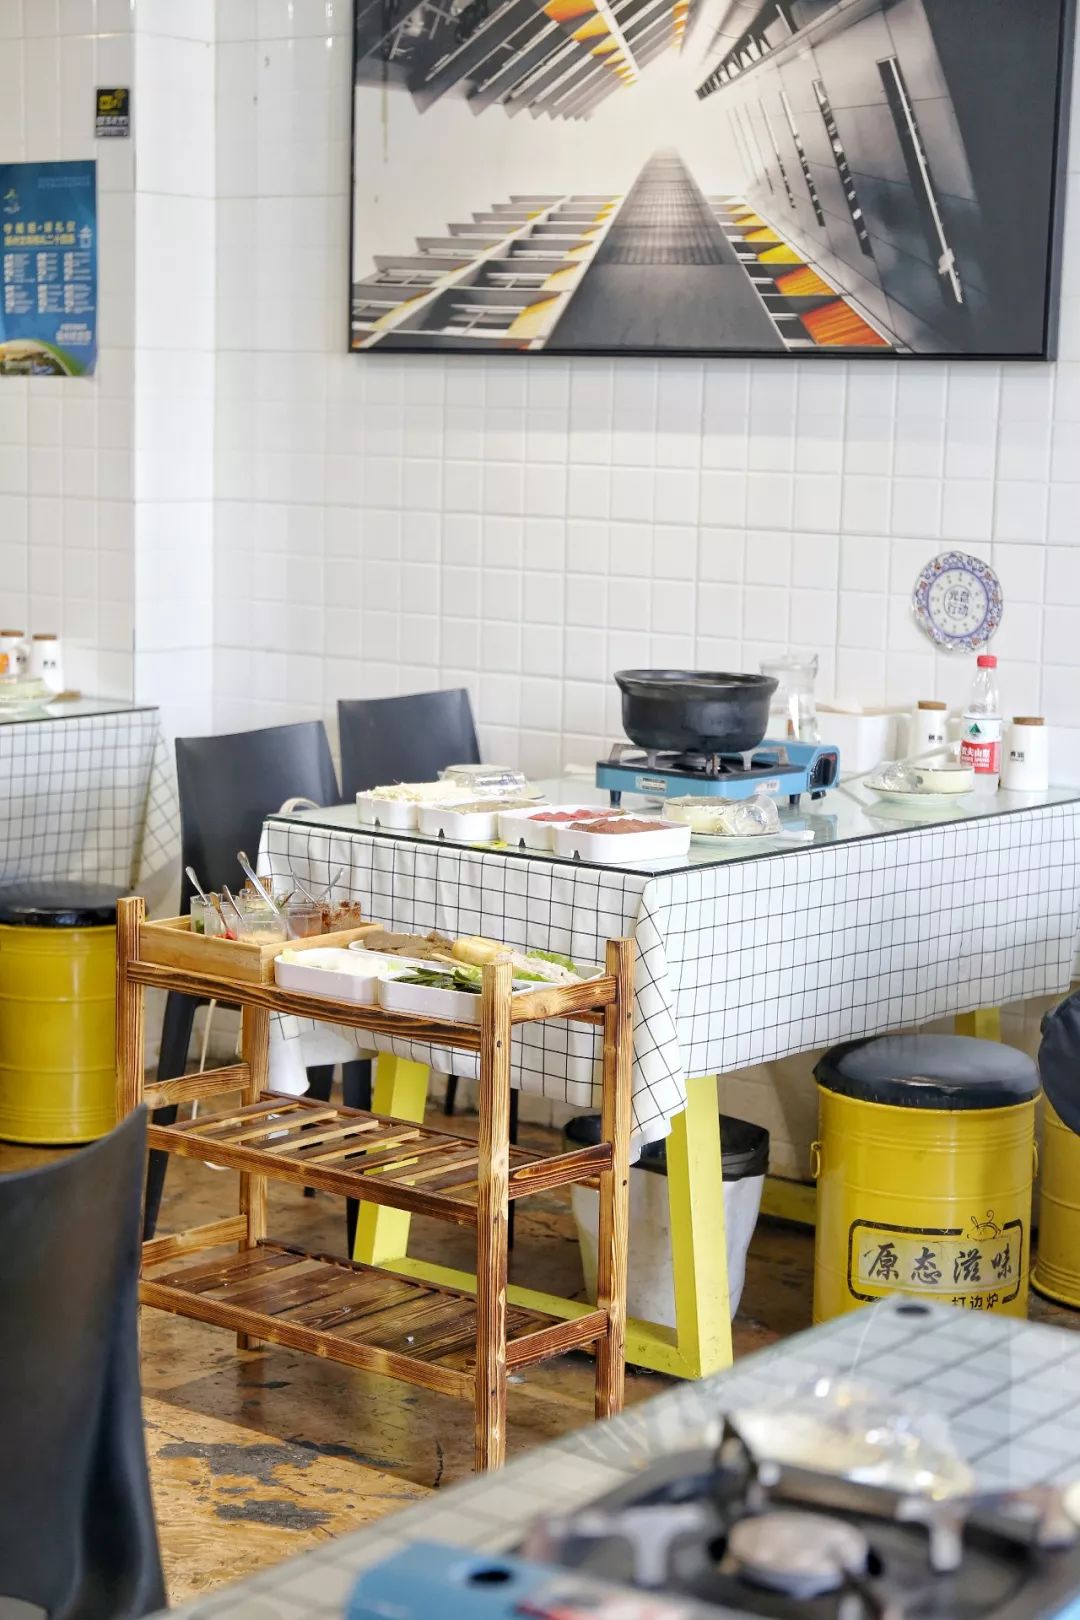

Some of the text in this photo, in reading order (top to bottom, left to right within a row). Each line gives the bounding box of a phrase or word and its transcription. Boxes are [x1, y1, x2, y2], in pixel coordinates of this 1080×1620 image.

[863, 1242, 1012, 1285] 原态滋味
[951, 1292, 999, 1310] 打边炉
